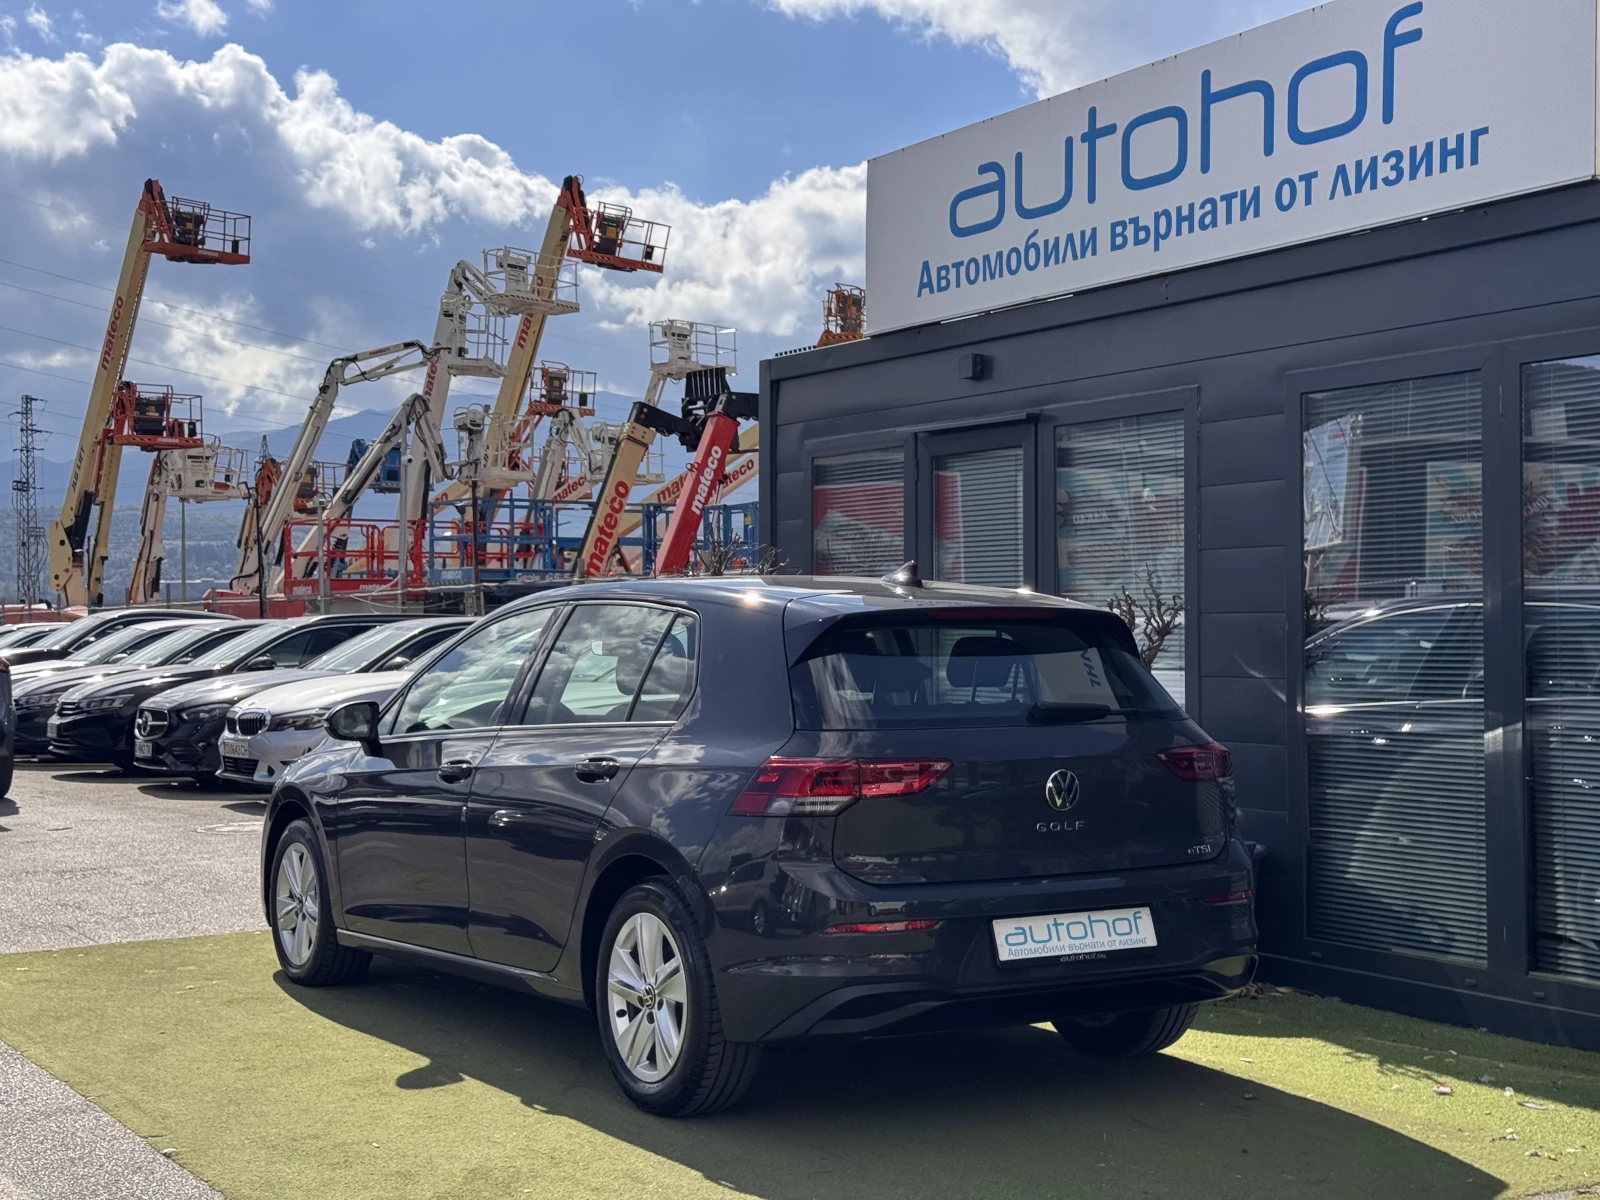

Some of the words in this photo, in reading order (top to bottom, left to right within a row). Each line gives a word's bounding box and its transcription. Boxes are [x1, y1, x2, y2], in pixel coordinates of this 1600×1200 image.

[949, 1, 1423, 237] autohof
[917, 228, 1098, 296] Автомобили
[1109, 186, 1260, 251] върнати
[1275, 172, 1318, 213] от
[1329, 127, 1489, 200] лизинг
[101, 296, 124, 371] mateco
[552, 473, 588, 503] matec
[691, 445, 722, 515] mateco
[585, 480, 630, 577] mateco
[1036, 821, 1085, 832] GOLF
[1187, 844, 1212, 855] eTSI
[1004, 911, 1143, 947] autohof
[1007, 943, 1066, 958] Автомобили
[1068, 940, 1105, 952] върнати
[1107, 939, 1117, 948] от
[1118, 936, 1148, 947] лизинг
